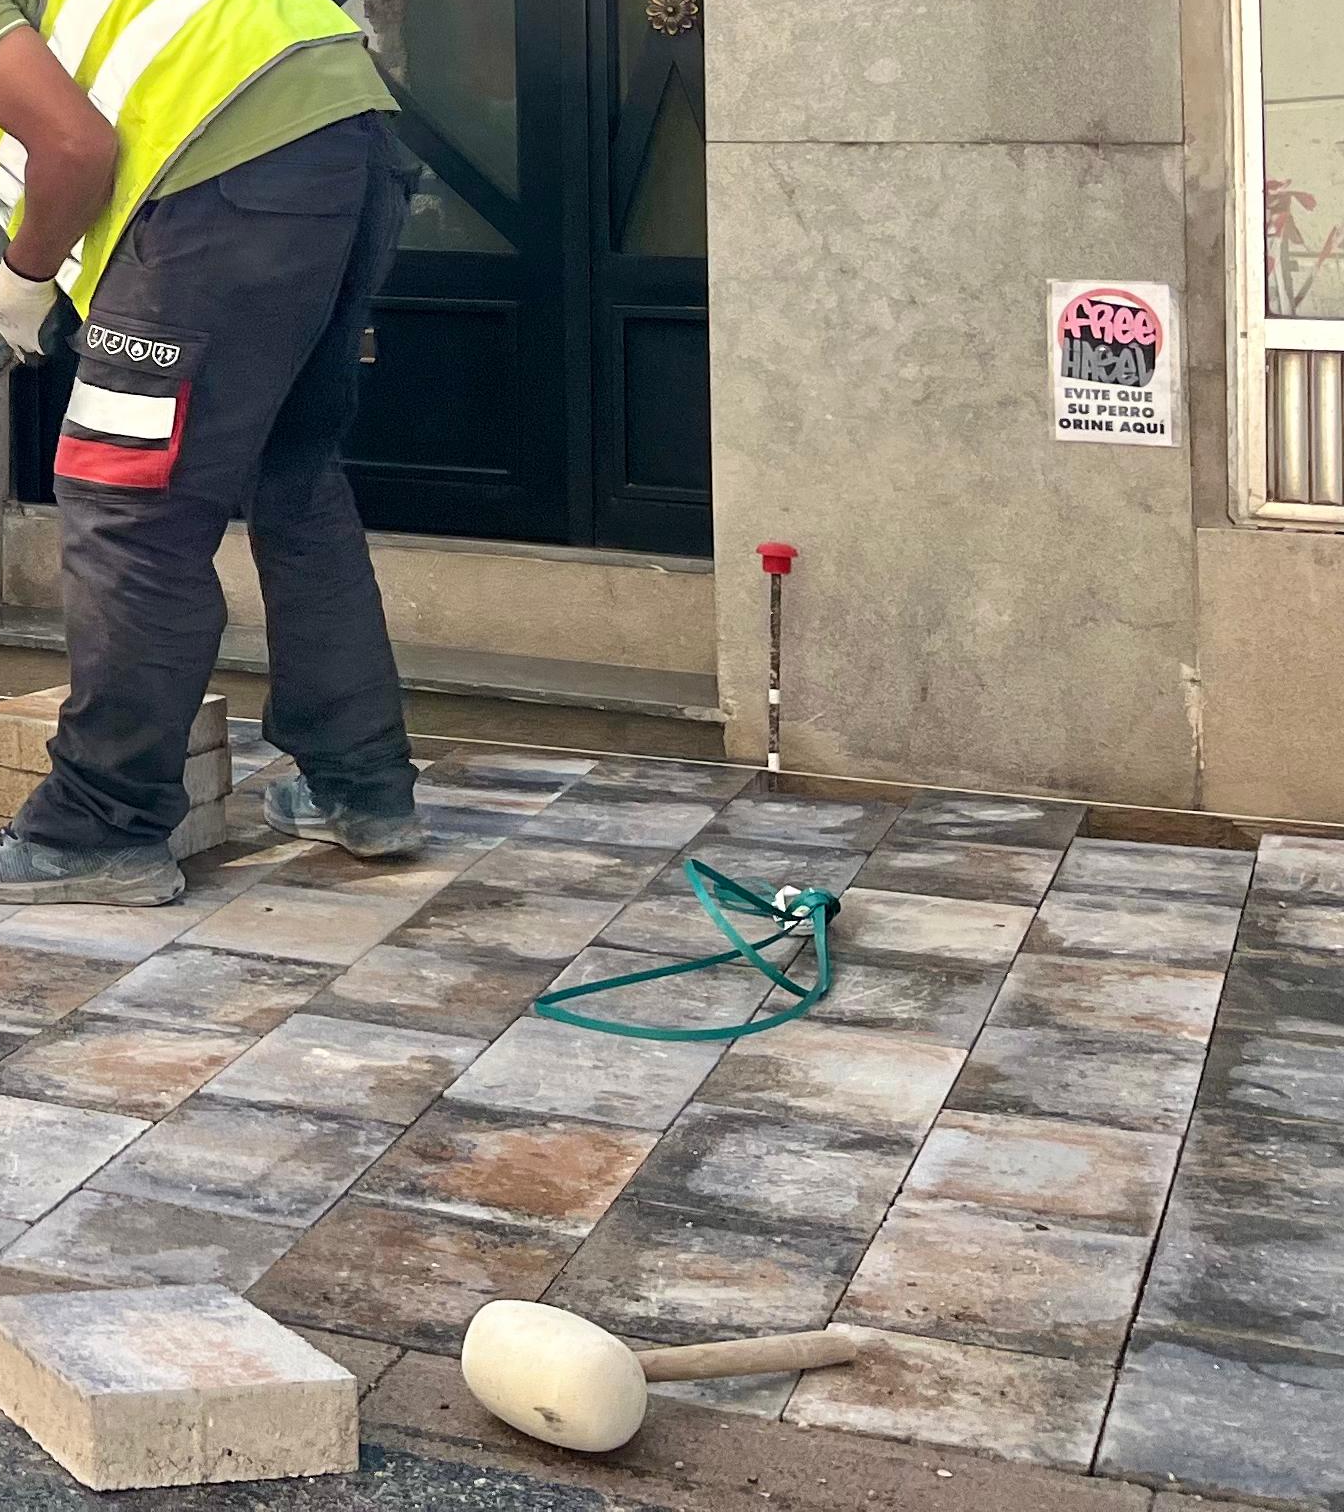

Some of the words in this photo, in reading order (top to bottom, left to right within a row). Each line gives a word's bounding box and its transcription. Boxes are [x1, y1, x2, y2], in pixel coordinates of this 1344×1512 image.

[1064, 388, 1110, 401] EVITE
[1117, 389, 1153, 403] QUE
[1067, 403, 1089, 415] SU
[1097, 404, 1155, 418] PERRO
[1058, 418, 1114, 432] ORINE
[1120, 420, 1165, 435] AQUÍ
